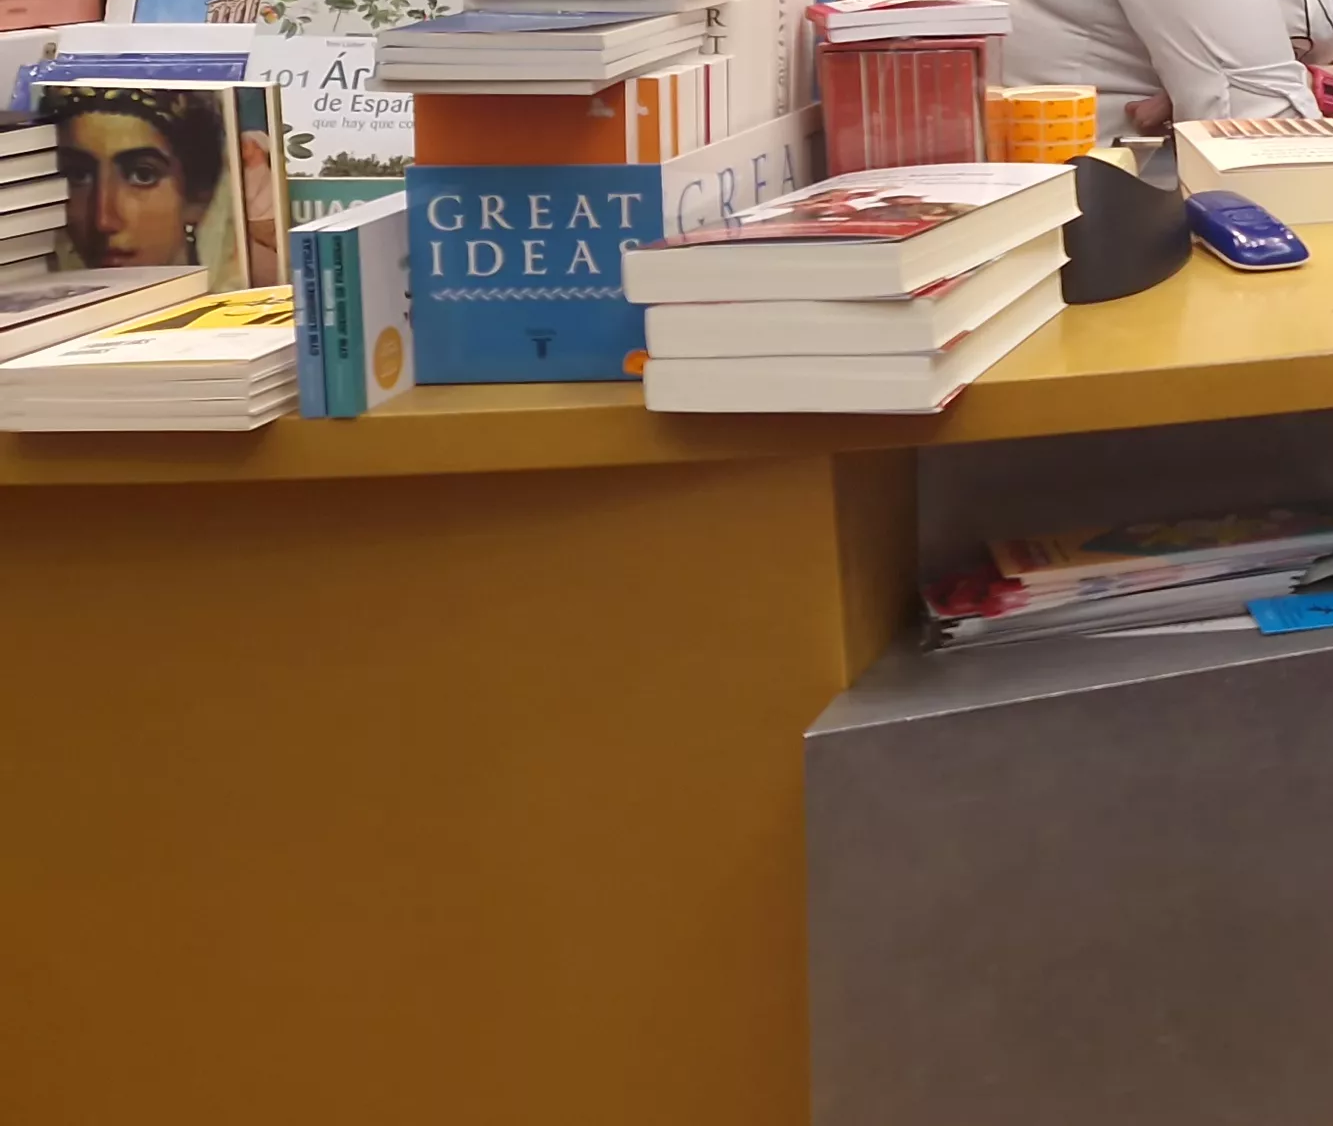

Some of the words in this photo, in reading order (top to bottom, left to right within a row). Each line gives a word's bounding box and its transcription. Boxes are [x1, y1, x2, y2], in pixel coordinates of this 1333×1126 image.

[260, 68, 310, 89] 101
[313, 93, 342, 113] de
[351, 93, 414, 119] Españ
[313, 119, 337, 131] que
[342, 117, 364, 131] hay
[370, 119, 393, 131] que
[427, 192, 641, 233] GREAT
